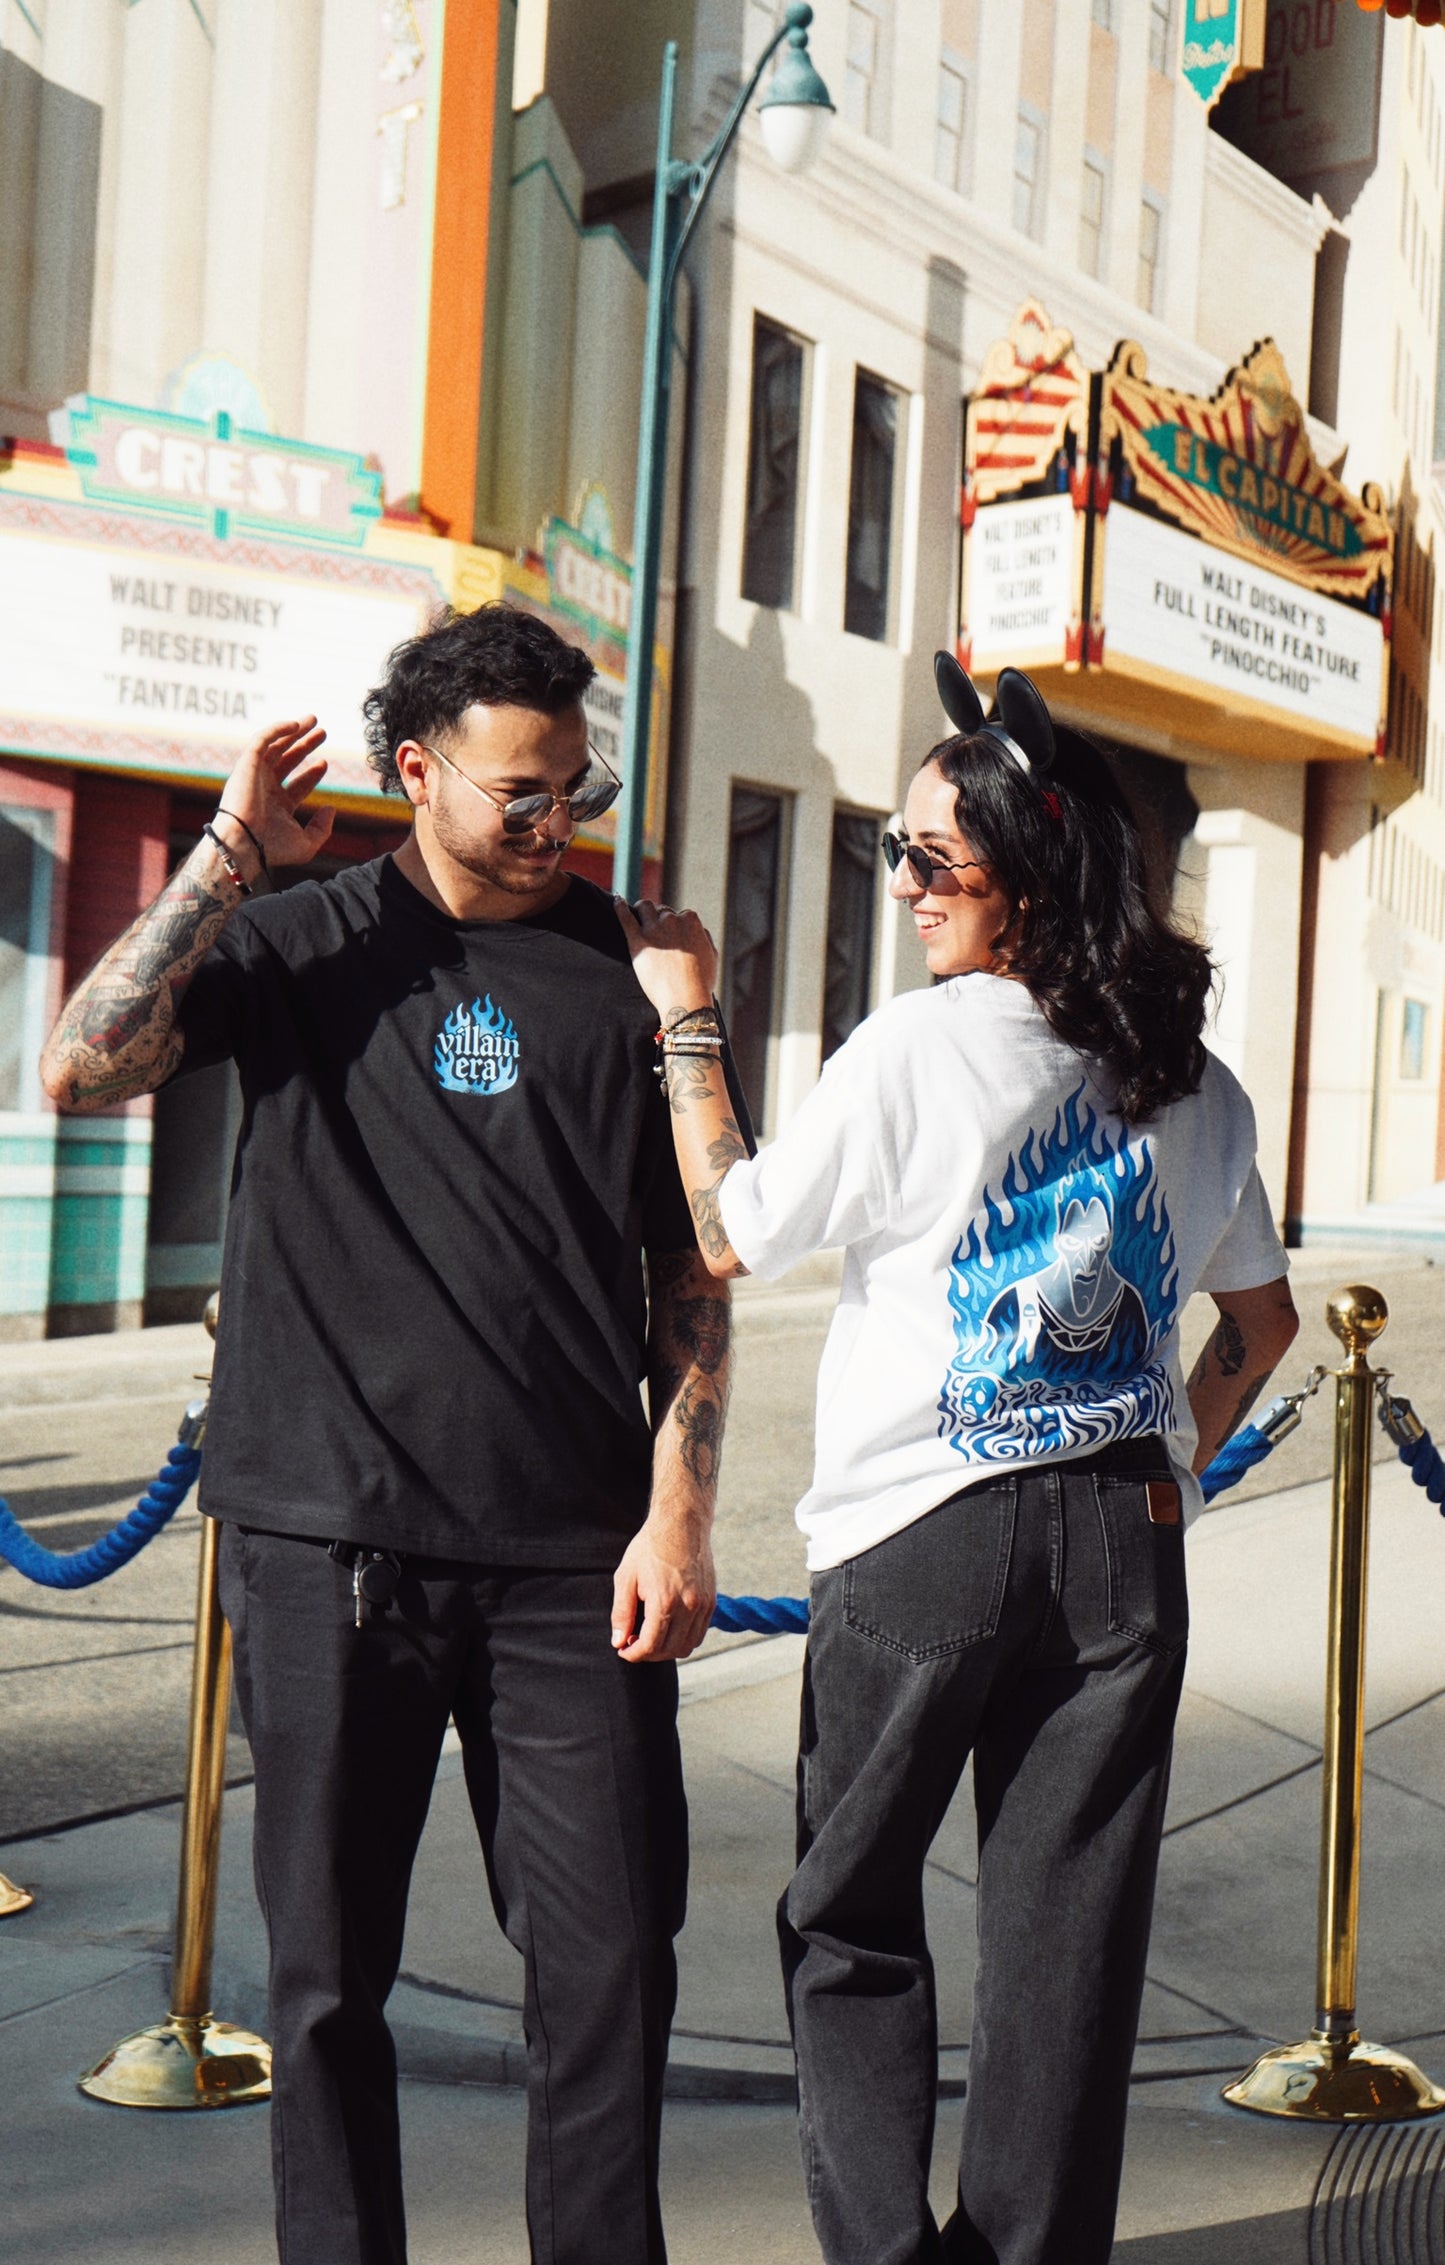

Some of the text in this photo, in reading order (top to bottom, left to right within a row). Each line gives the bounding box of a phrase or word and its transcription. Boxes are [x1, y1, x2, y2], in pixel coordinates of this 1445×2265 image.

[115, 428, 331, 518] CREST
[1174, 429, 1346, 549] EL CAPITAN
[108, 573, 285, 630] WALT DISNEY
[1201, 563, 1327, 637] WALT DISNEY'S
[120, 625, 259, 674] PRESENTS
[1154, 579, 1361, 682] FULL LENGTH FEATURE
[103, 671, 266, 720] "FANTASIA"
[437, 1024, 520, 1058] villain
[455, 1056, 498, 1081] era
